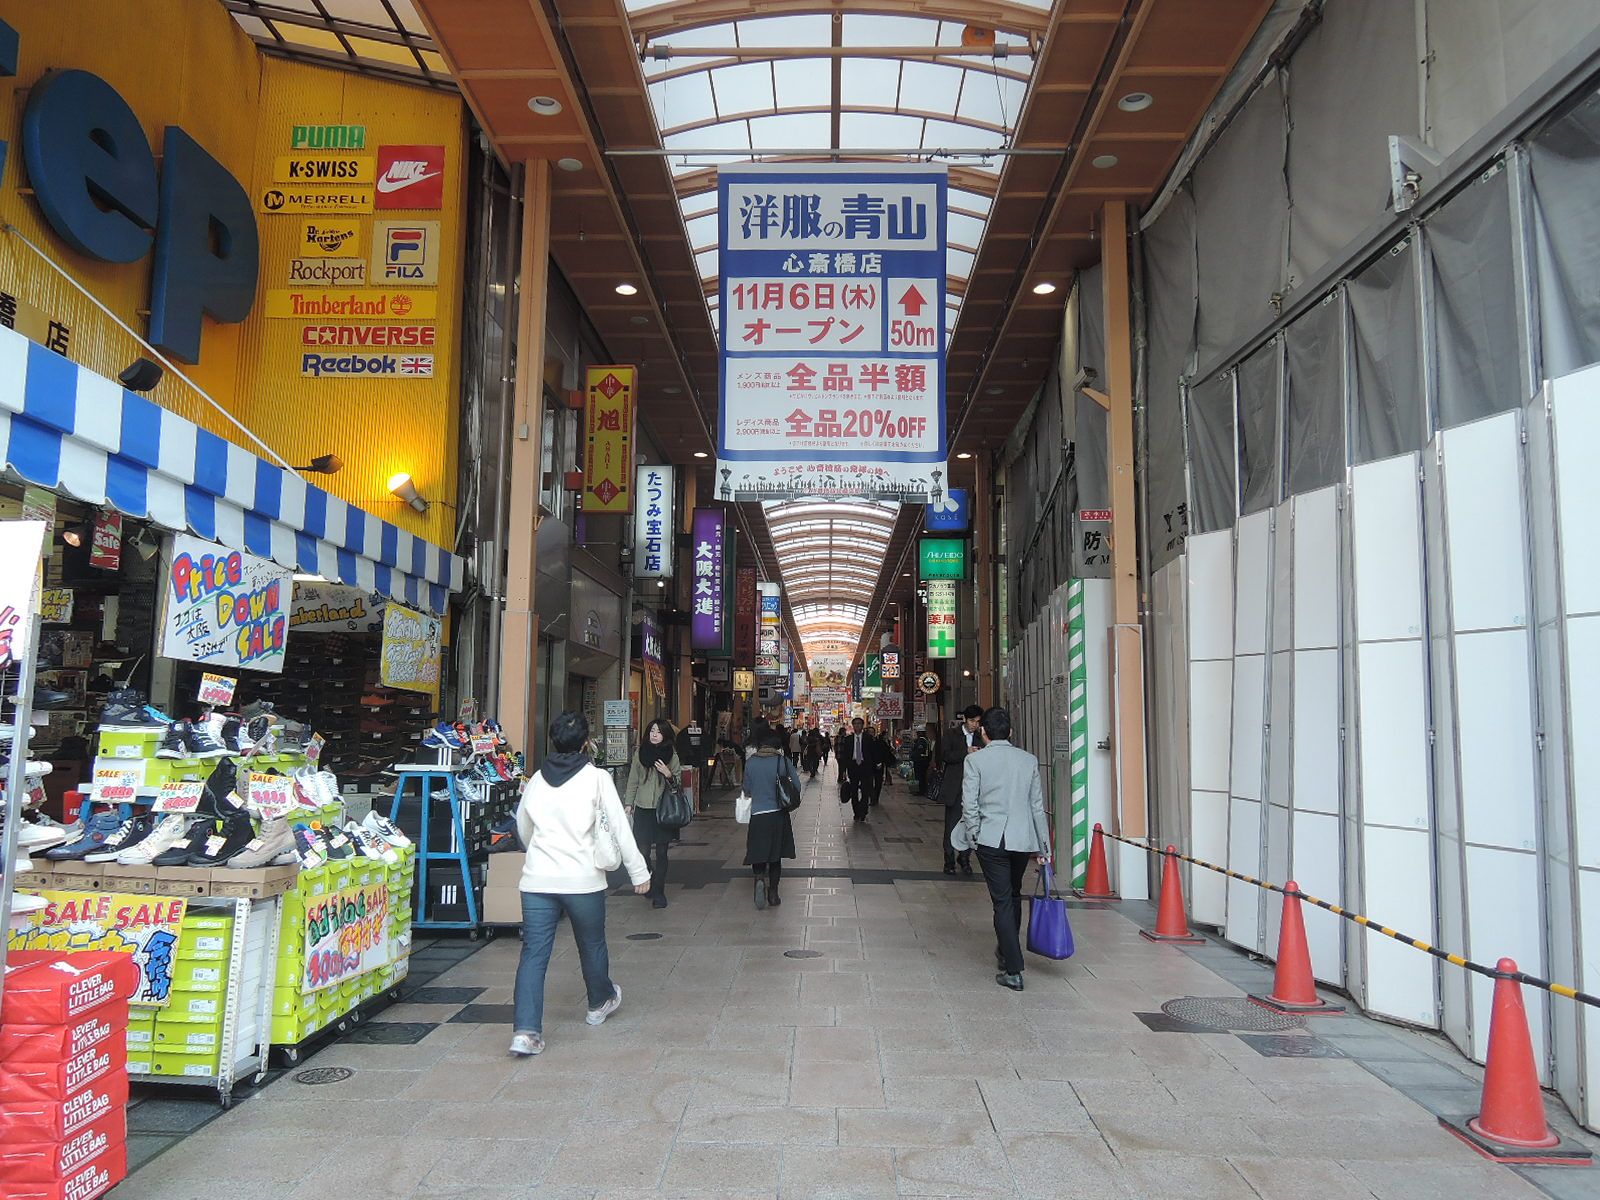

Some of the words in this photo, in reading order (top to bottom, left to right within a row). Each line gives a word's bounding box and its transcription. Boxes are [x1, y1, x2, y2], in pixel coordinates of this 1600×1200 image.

[291, 126, 364, 148] PUMA
[387, 161, 428, 179] NIKE
[289, 195, 369, 204] MERRELL
[740, 194, 926, 240] 洋服の青山
[289, 259, 364, 284] Rockport
[386, 266, 424, 279] FILA
[290, 294, 387, 315] Timberland
[302, 326, 435, 345] CONVERSE
[742, 316, 864, 346] オープン
[890, 320, 935, 346] 50m
[302, 353, 396, 376] Reebok
[785, 362, 926, 392] 全品半額
[644, 471, 662, 572] たつみ宝石店
[94, 532, 121, 550] Sale
[171, 551, 242, 604] Price
[694, 541, 714, 615] 大阪大進
[216, 579, 280, 629] DOWN
[928, 613, 956, 625] 薬局
[235, 615, 285, 664] SALE
[97, 770, 120, 779] SALE
[161, 783, 184, 791] SALE
[251, 773, 273, 783] SALE
[42, 895, 112, 927] SALE
[114, 900, 183, 931] SALE
[68, 986, 100, 1009] LITTLE
[99, 979, 114, 997] BAG
[69, 973, 102, 995] CLEVER
[94, 1023, 110, 1041] BAG
[66, 1048, 97, 1073] CLEVER
[66, 1065, 94, 1090] LITTLE
[92, 1053, 110, 1074] BAG
[63, 1089, 93, 1114] CLEVER
[63, 1105, 92, 1129] LITTLE
[91, 1093, 109, 1114] BAG
[60, 1143, 90, 1170] LITTLE
[88, 1132, 107, 1153] BAG
[61, 1129, 94, 1157] CLEVER
[64, 1165, 97, 1194] CLEVER
[92, 1169, 109, 1190] BAG
